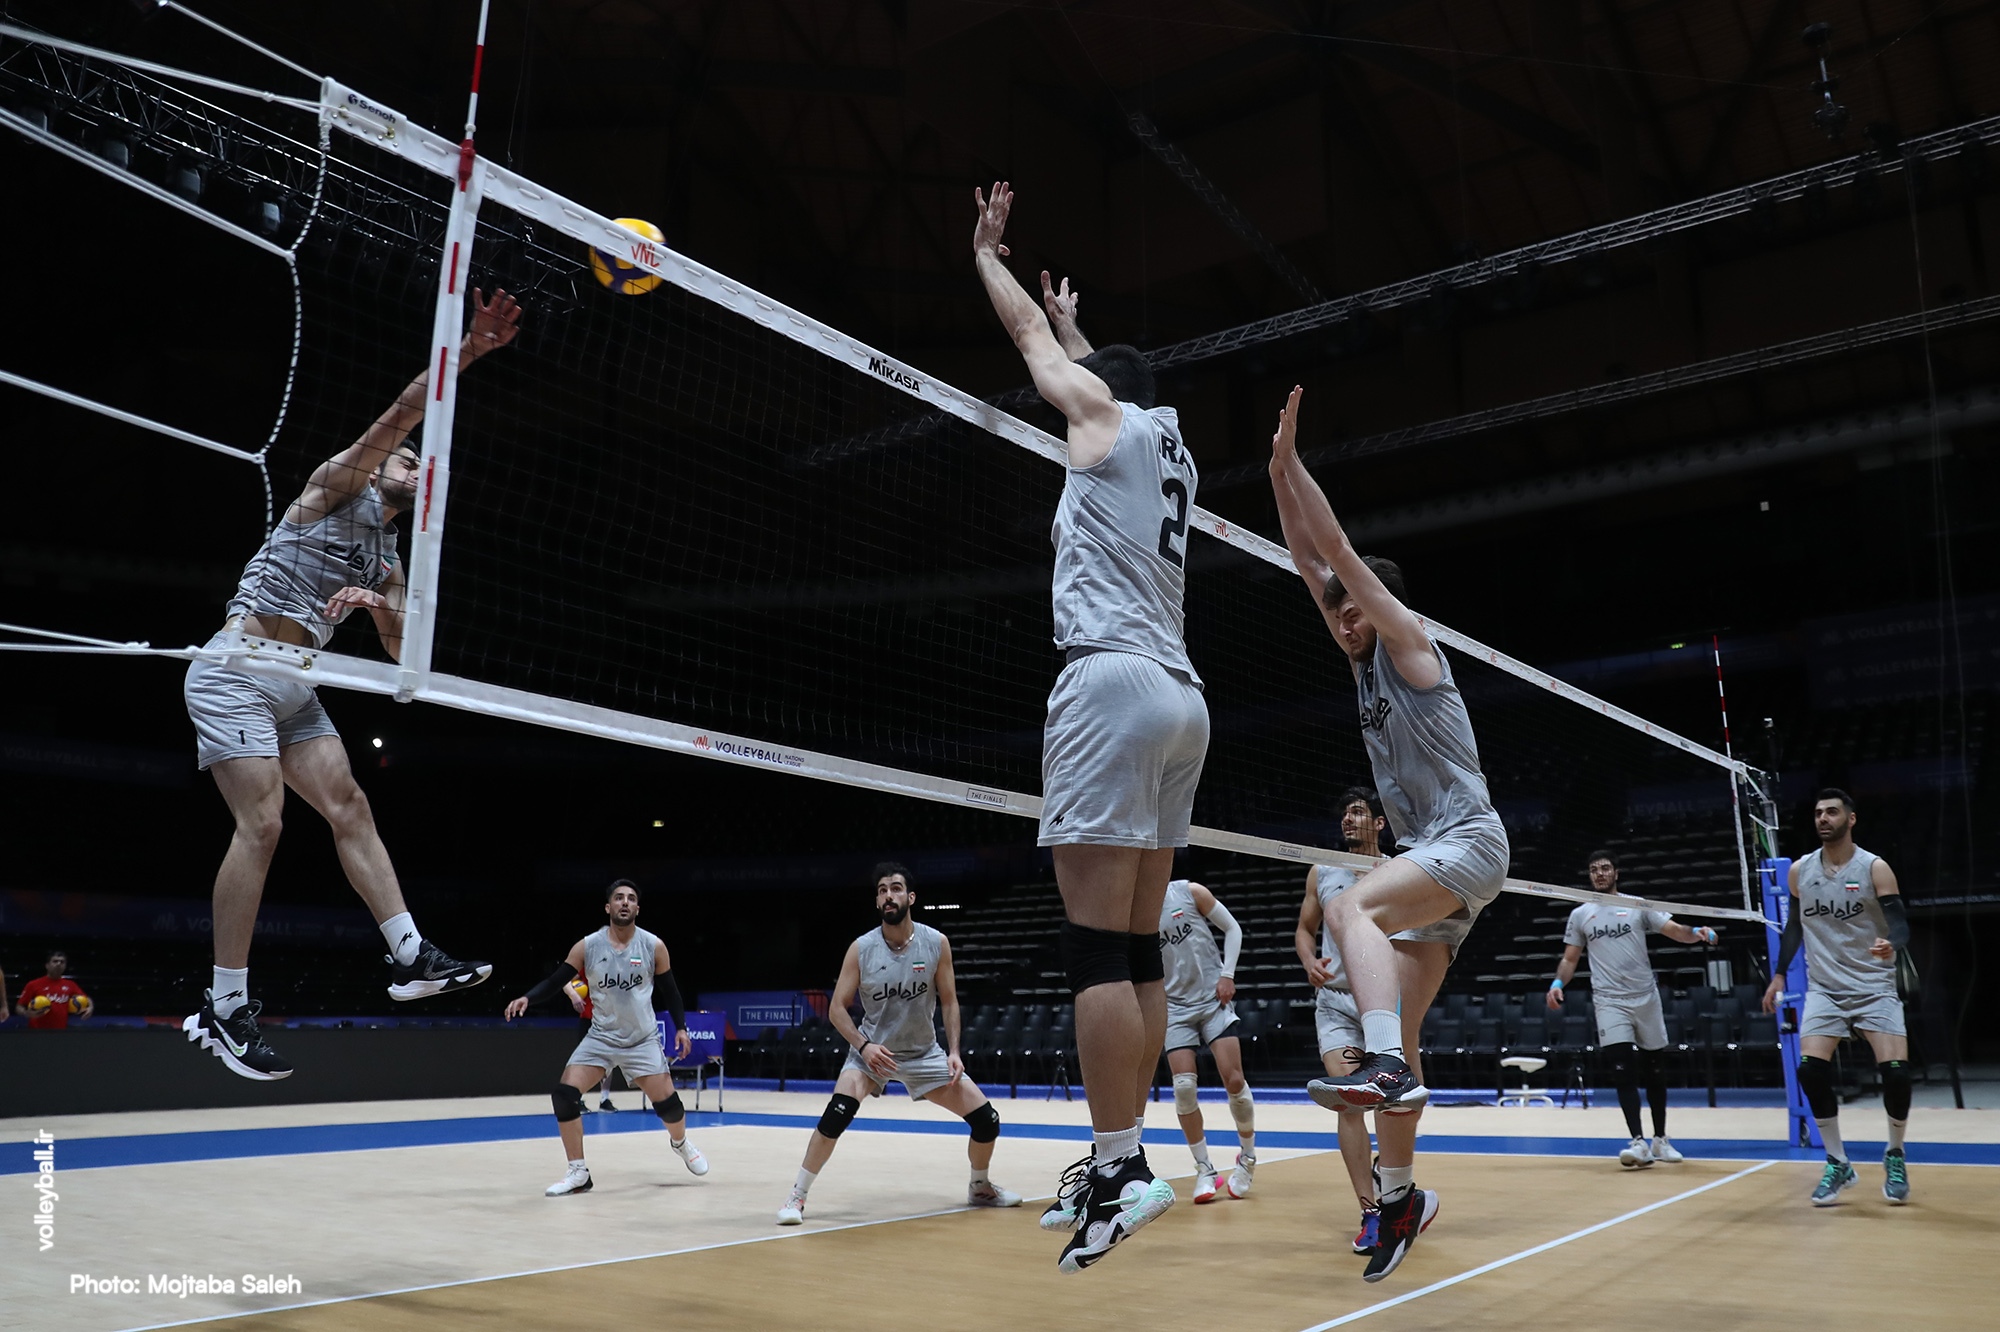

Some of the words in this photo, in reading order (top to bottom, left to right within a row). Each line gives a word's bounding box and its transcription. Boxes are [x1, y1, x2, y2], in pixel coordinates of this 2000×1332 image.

[358, 99, 396, 124] Senoh
[1158, 478, 1189, 570] 2
[238, 730, 246, 745] 1
[715, 740, 783, 764] VOLLEYBALL
[983, 794, 1003, 804] FINALS
[746, 1011, 761, 1020] THE
